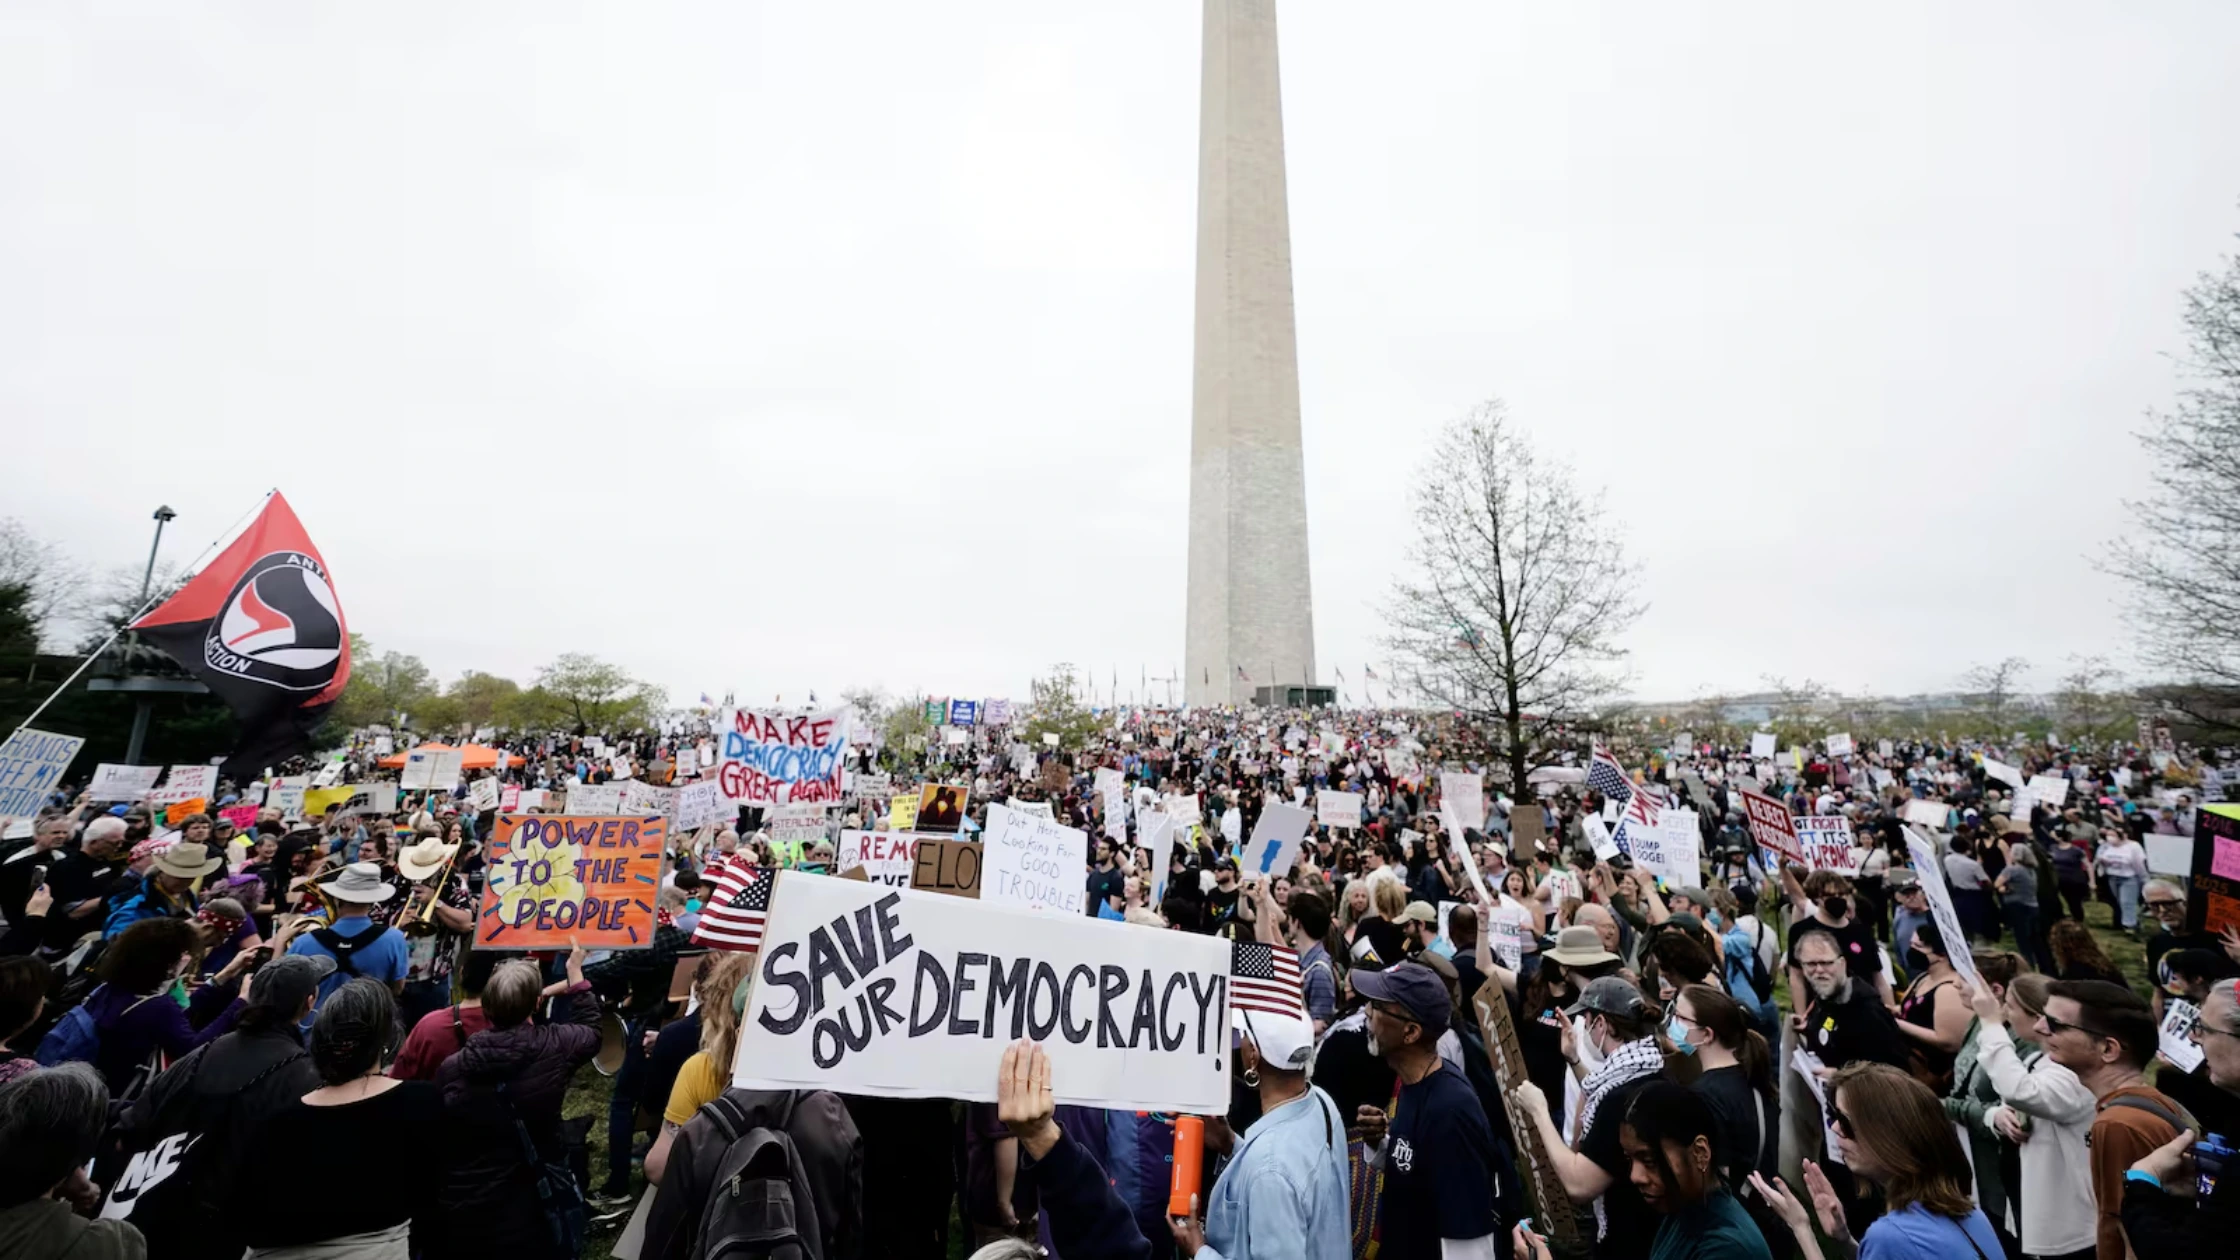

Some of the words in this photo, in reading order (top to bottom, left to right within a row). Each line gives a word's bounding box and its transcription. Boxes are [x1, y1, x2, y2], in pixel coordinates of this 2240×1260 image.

[207, 635, 252, 673] ACTION
[736, 710, 833, 747] MAKE
[725, 731, 844, 783] DEMOCRACY
[25, 764, 62, 790] MY
[720, 761, 786, 803] GREAT
[788, 765, 842, 803] AGAIN
[774, 817, 824, 830] STEALING
[1008, 812, 1028, 829] Out
[1037, 820, 1060, 839] Here
[1748, 797, 1790, 833] REJECT
[1811, 818, 1842, 830] RIGHT
[2202, 812, 2234, 835] 2016
[520, 818, 640, 849] POWER
[1002, 828, 1049, 856] Looking
[1056, 844, 1076, 858] For
[511, 859, 551, 886] TO
[574, 857, 629, 884] THE
[1021, 852, 1060, 879] GOOD
[1810, 844, 1856, 869] WRONG
[999, 868, 1083, 914] TROUBLE!
[2193, 873, 2229, 895] 2025
[513, 897, 630, 931] PEOPLE
[757, 891, 914, 1036] SAVE
[812, 976, 906, 1070] OUR
[908, 949, 1227, 1073] DEMOCRACY!
